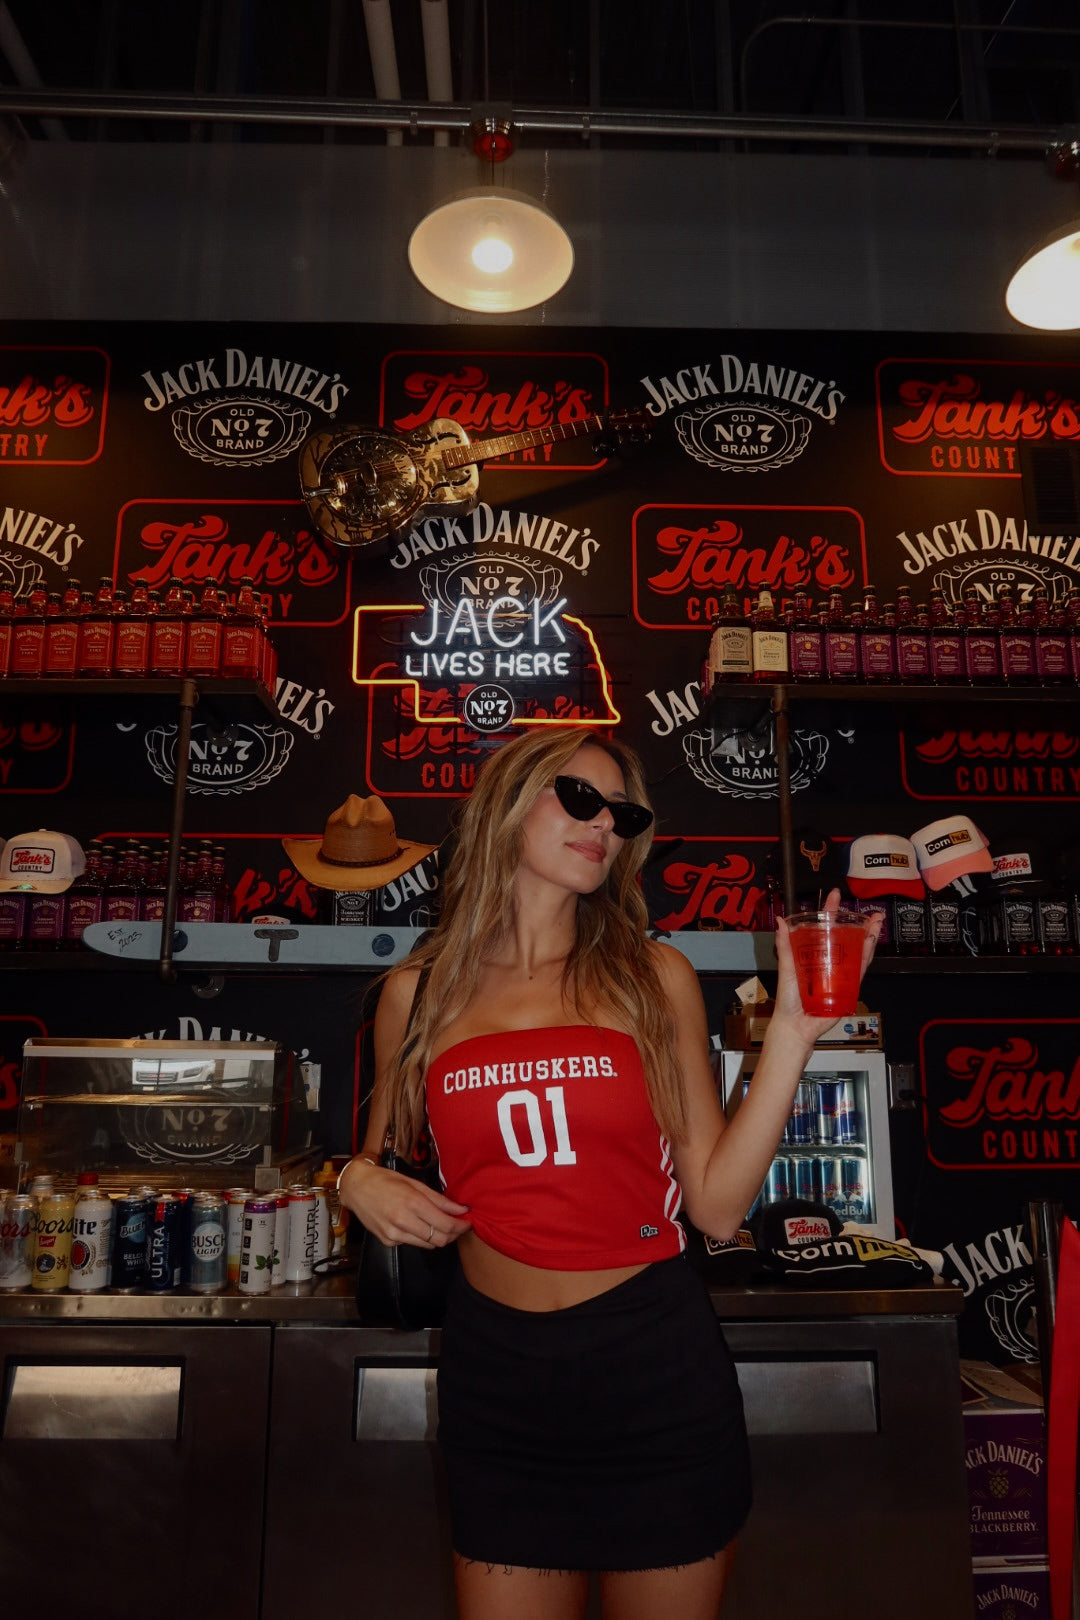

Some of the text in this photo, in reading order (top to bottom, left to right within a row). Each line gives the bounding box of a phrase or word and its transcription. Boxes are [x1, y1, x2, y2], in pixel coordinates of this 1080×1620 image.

[141, 348, 350, 415] JACK DANIEL'S
[640, 354, 846, 421] JACK DANIEL'S
[230, 409, 254, 417] OLD
[393, 366, 593, 434] Tank's
[893, 373, 1080, 444] Tank's
[731, 415, 755, 423] OLD
[216, 438, 264, 450] BRAND
[719, 443, 768, 455] BRAND
[931, 445, 1016, 471] COUNT
[390, 502, 600, 571] JACK DANIEL'S
[896, 518, 978, 575] JACK
[128, 515, 338, 586] Tank's
[647, 519, 855, 596] Tank's
[479, 565, 504, 574] OLD
[990, 572, 1015, 581] OLD
[410, 596, 568, 647] JACK
[405, 652, 571, 678] LIVES HERE
[481, 691, 498, 699] OLD
[646, 680, 701, 737] JAC
[477, 717, 503, 726] BRAND
[192, 762, 244, 776] BRAND
[956, 765, 1080, 793] COUNTRY
[13, 850, 51, 866] Tank's
[993, 857, 1028, 874] Tank's
[383, 850, 439, 912] JAC
[496, 1086, 577, 1167] 01
[982, 1129, 1078, 1160] COUNT
[788, 1219, 830, 1239] Tank's
[151, 1223, 165, 1278] ULTRA
[197, 1247, 220, 1255] LIGHT
[943, 1224, 1033, 1297] JACK
[987, 1440, 1043, 1475] DANIEL'S
[972, 1505, 1031, 1522] Tennessee
[977, 1584, 1039, 1610] JACK DANIEL'S
